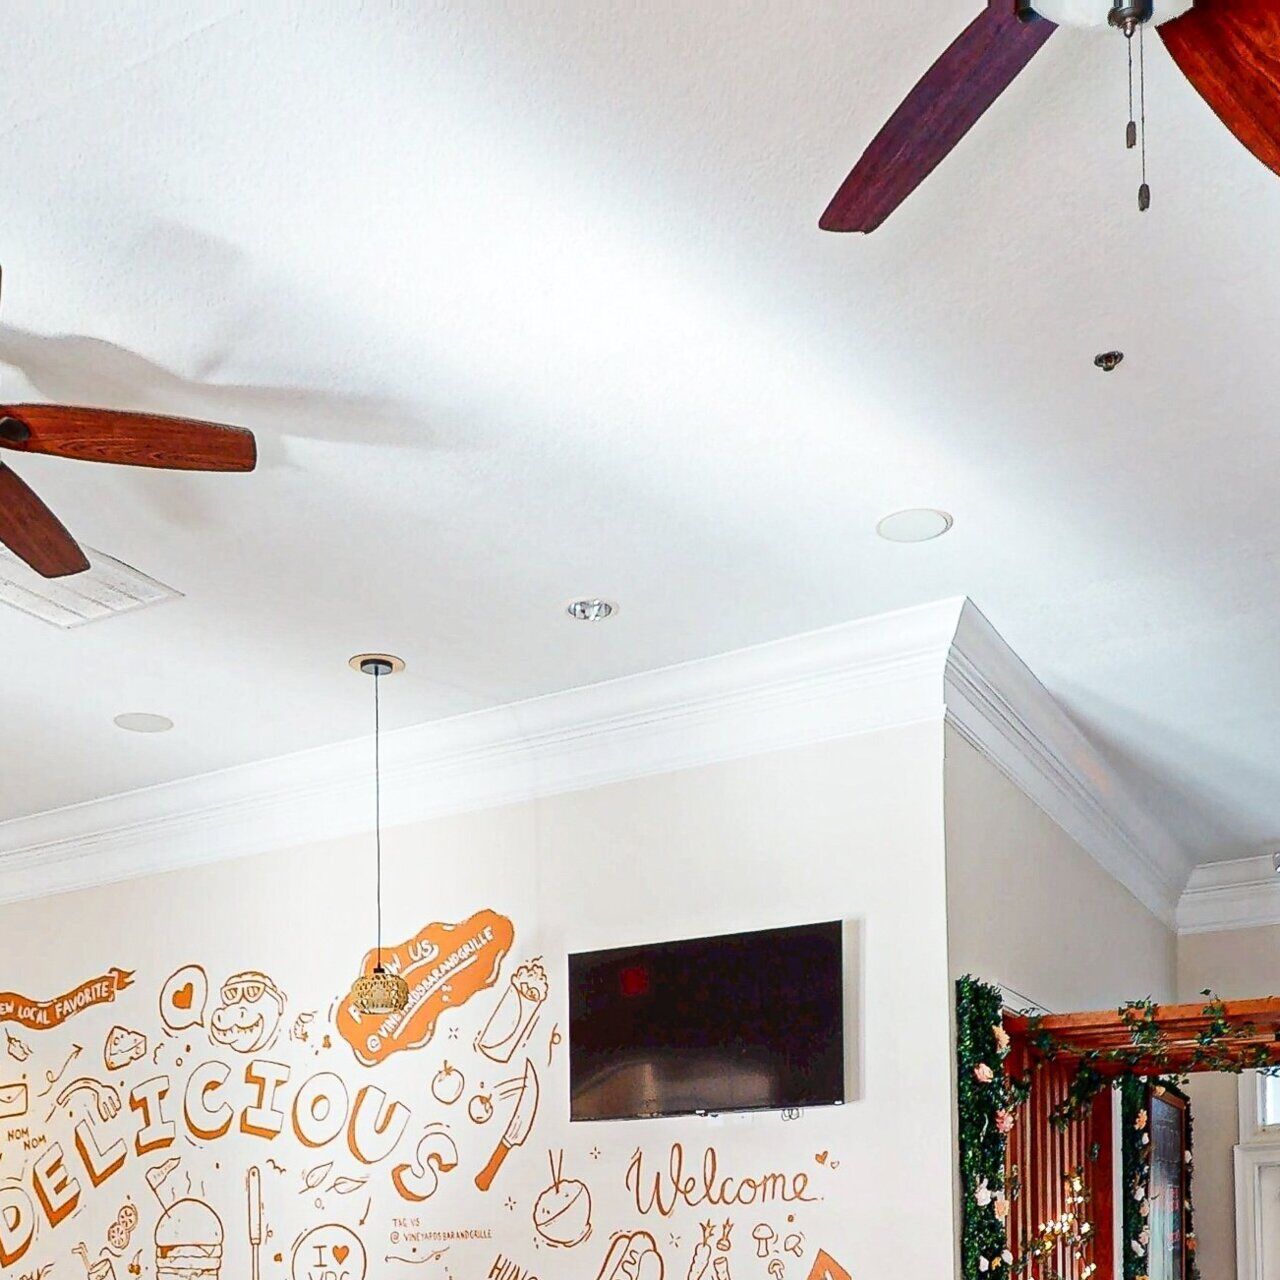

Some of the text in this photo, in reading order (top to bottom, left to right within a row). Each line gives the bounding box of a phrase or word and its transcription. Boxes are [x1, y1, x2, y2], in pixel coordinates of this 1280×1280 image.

[408, 939, 433, 960] US
[18, 1003, 50, 1024] LOCAL
[54, 981, 110, 1018] FAVORITE
[7, 1127, 29, 1141] NOM
[24, 1135, 46, 1150] NOM
[313, 1245, 327, 1268] I
